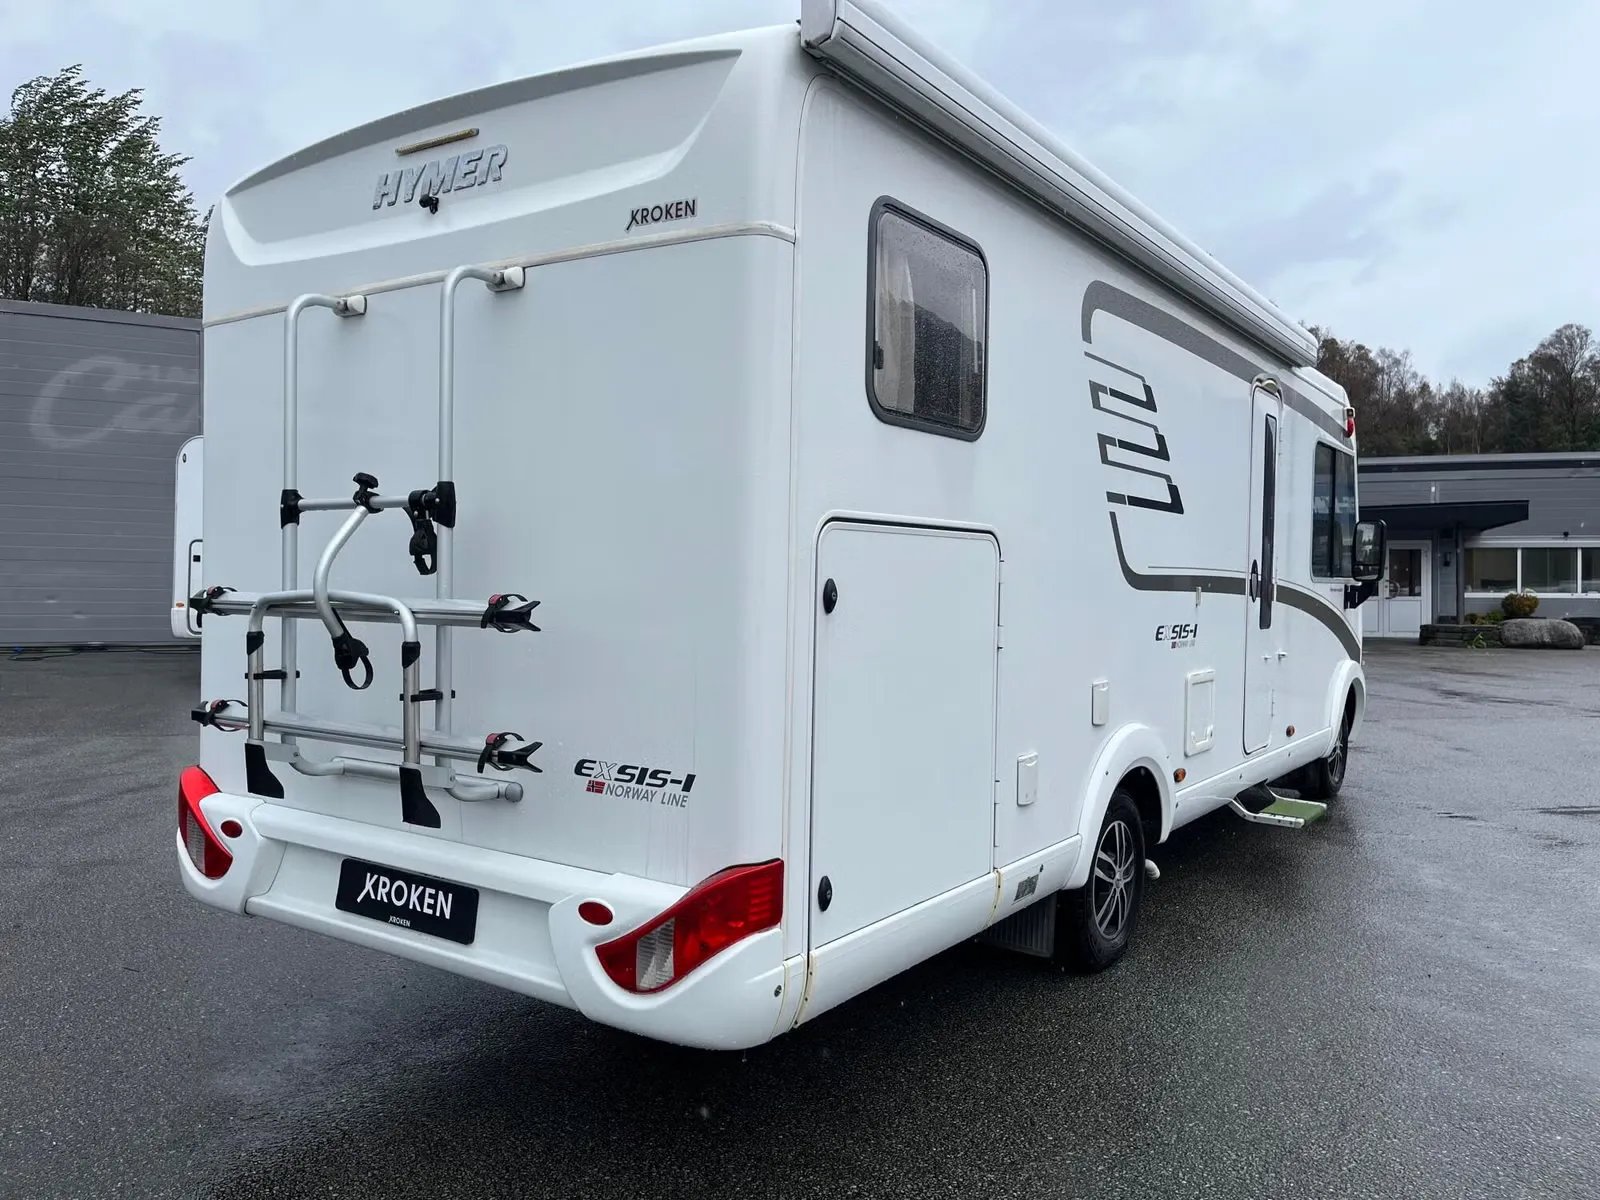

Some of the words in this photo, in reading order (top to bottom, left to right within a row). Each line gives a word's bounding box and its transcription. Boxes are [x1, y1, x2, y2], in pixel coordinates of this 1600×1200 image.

[372, 144, 509, 210] HYMER
[626, 199, 697, 232] KROKEN
[574, 758, 697, 793] EXSIS-I
[605, 783, 658, 803] NORWAY
[660, 791, 689, 808] LINE
[356, 872, 453, 920] KROKEN
[388, 915, 411, 928] KROKEN
